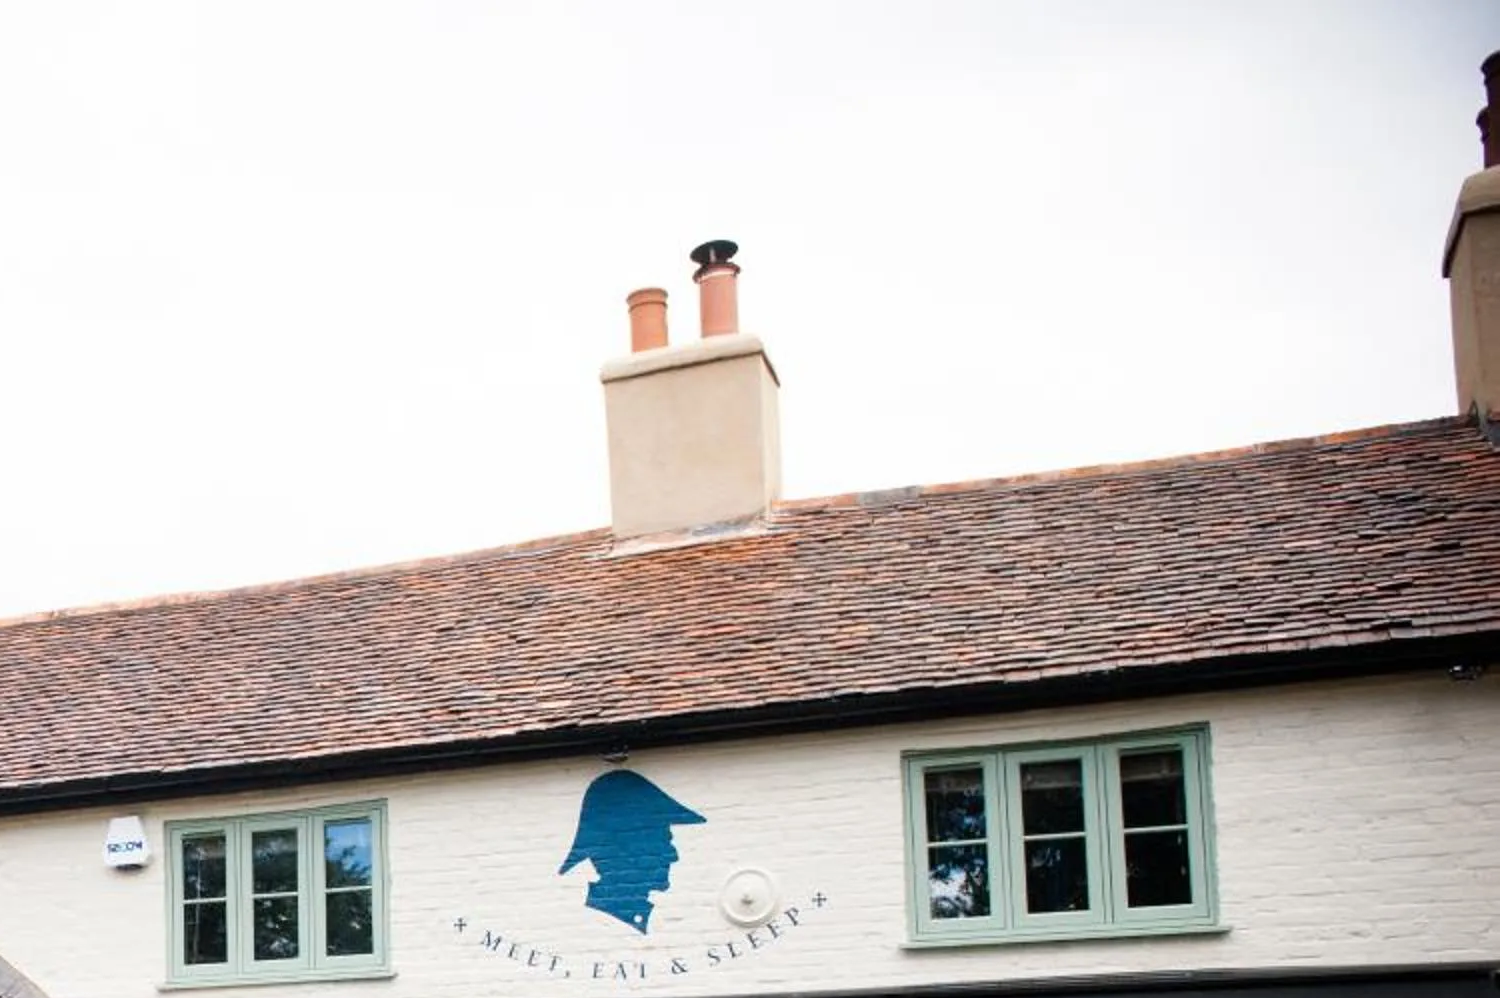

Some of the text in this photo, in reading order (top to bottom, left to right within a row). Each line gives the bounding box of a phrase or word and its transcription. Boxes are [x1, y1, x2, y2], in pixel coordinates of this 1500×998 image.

[480, 906, 802, 981] MEET, EAT & SLEEP
